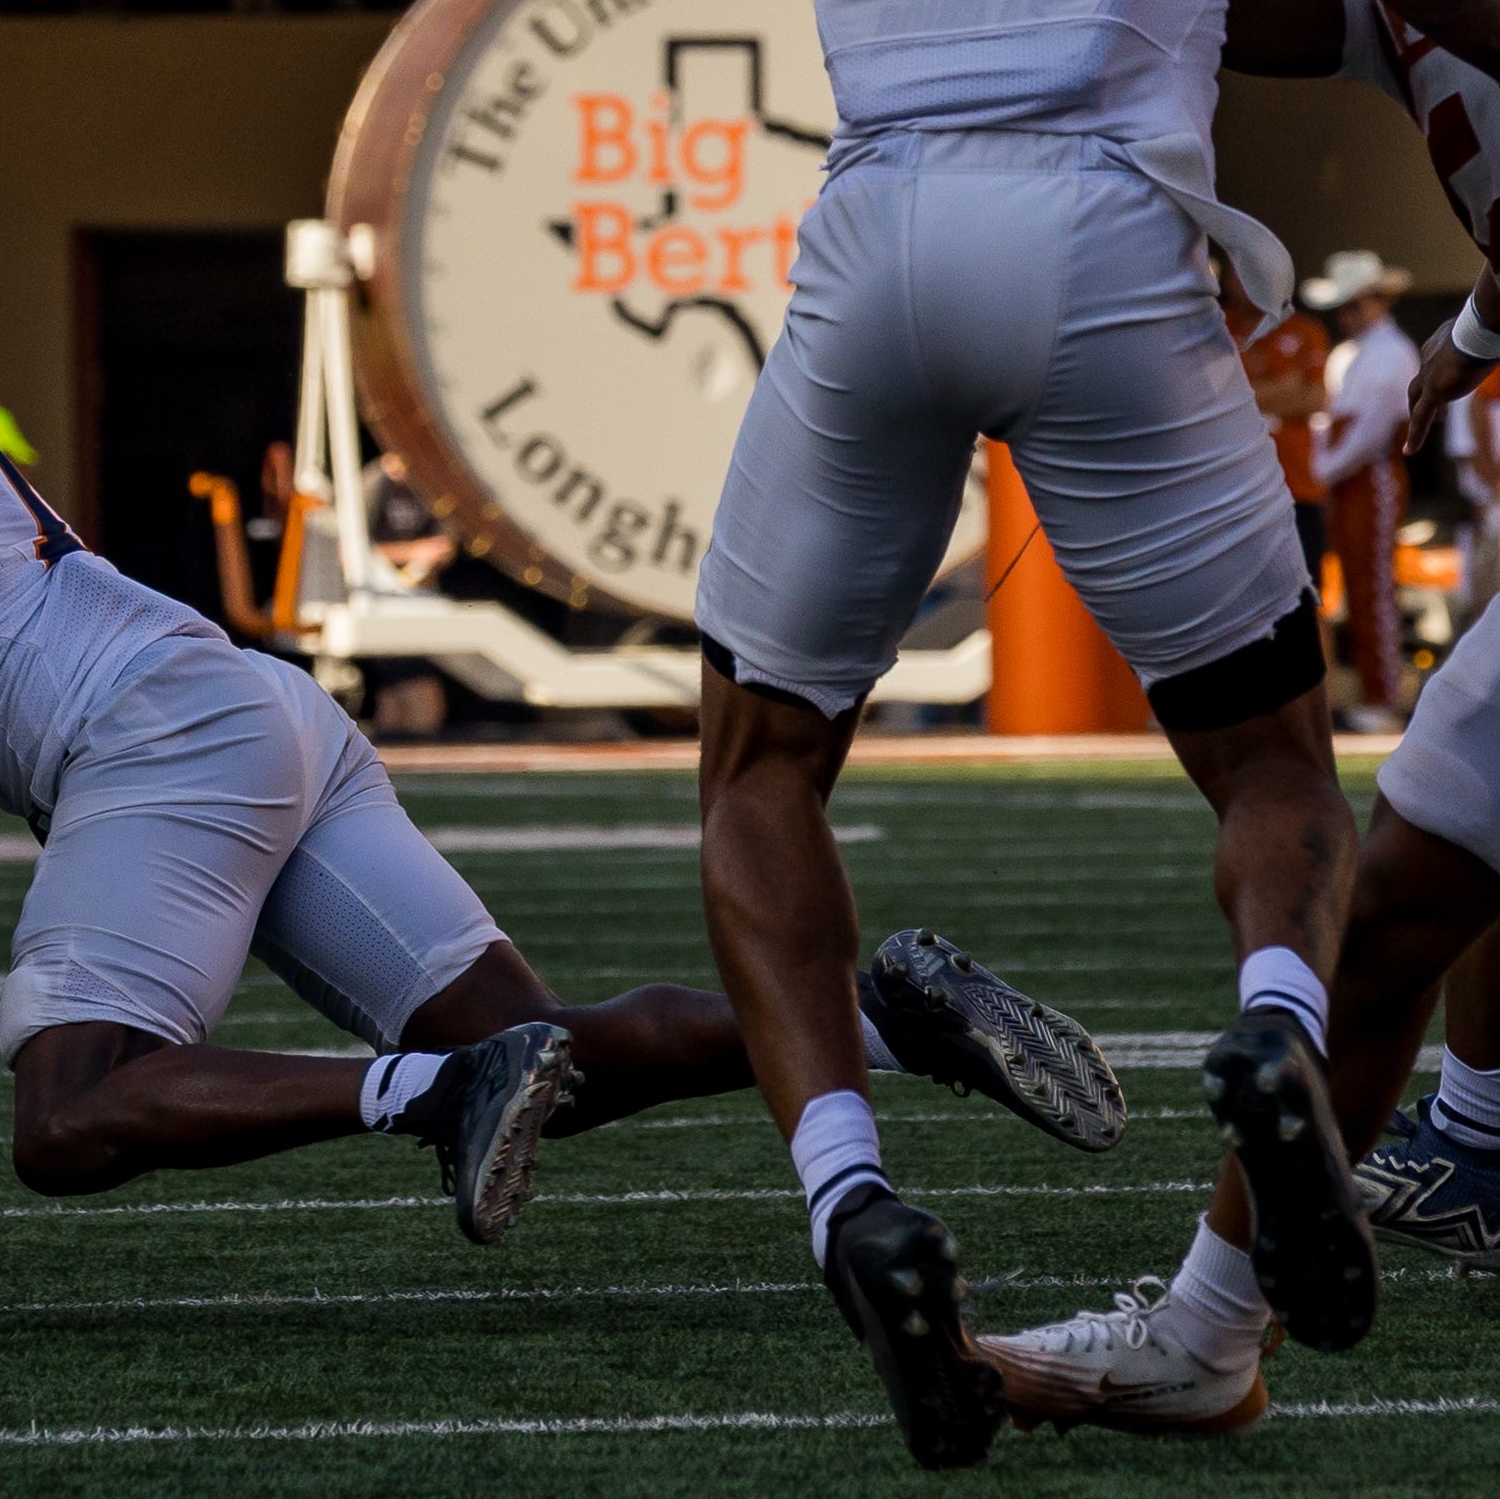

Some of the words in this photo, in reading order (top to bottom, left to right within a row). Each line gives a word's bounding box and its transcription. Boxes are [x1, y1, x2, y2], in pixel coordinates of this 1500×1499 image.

[443, 61, 539, 173] The
[572, 91, 753, 212] Big
[572, 200, 818, 295] Bert
[480, 376, 699, 575] Longh
